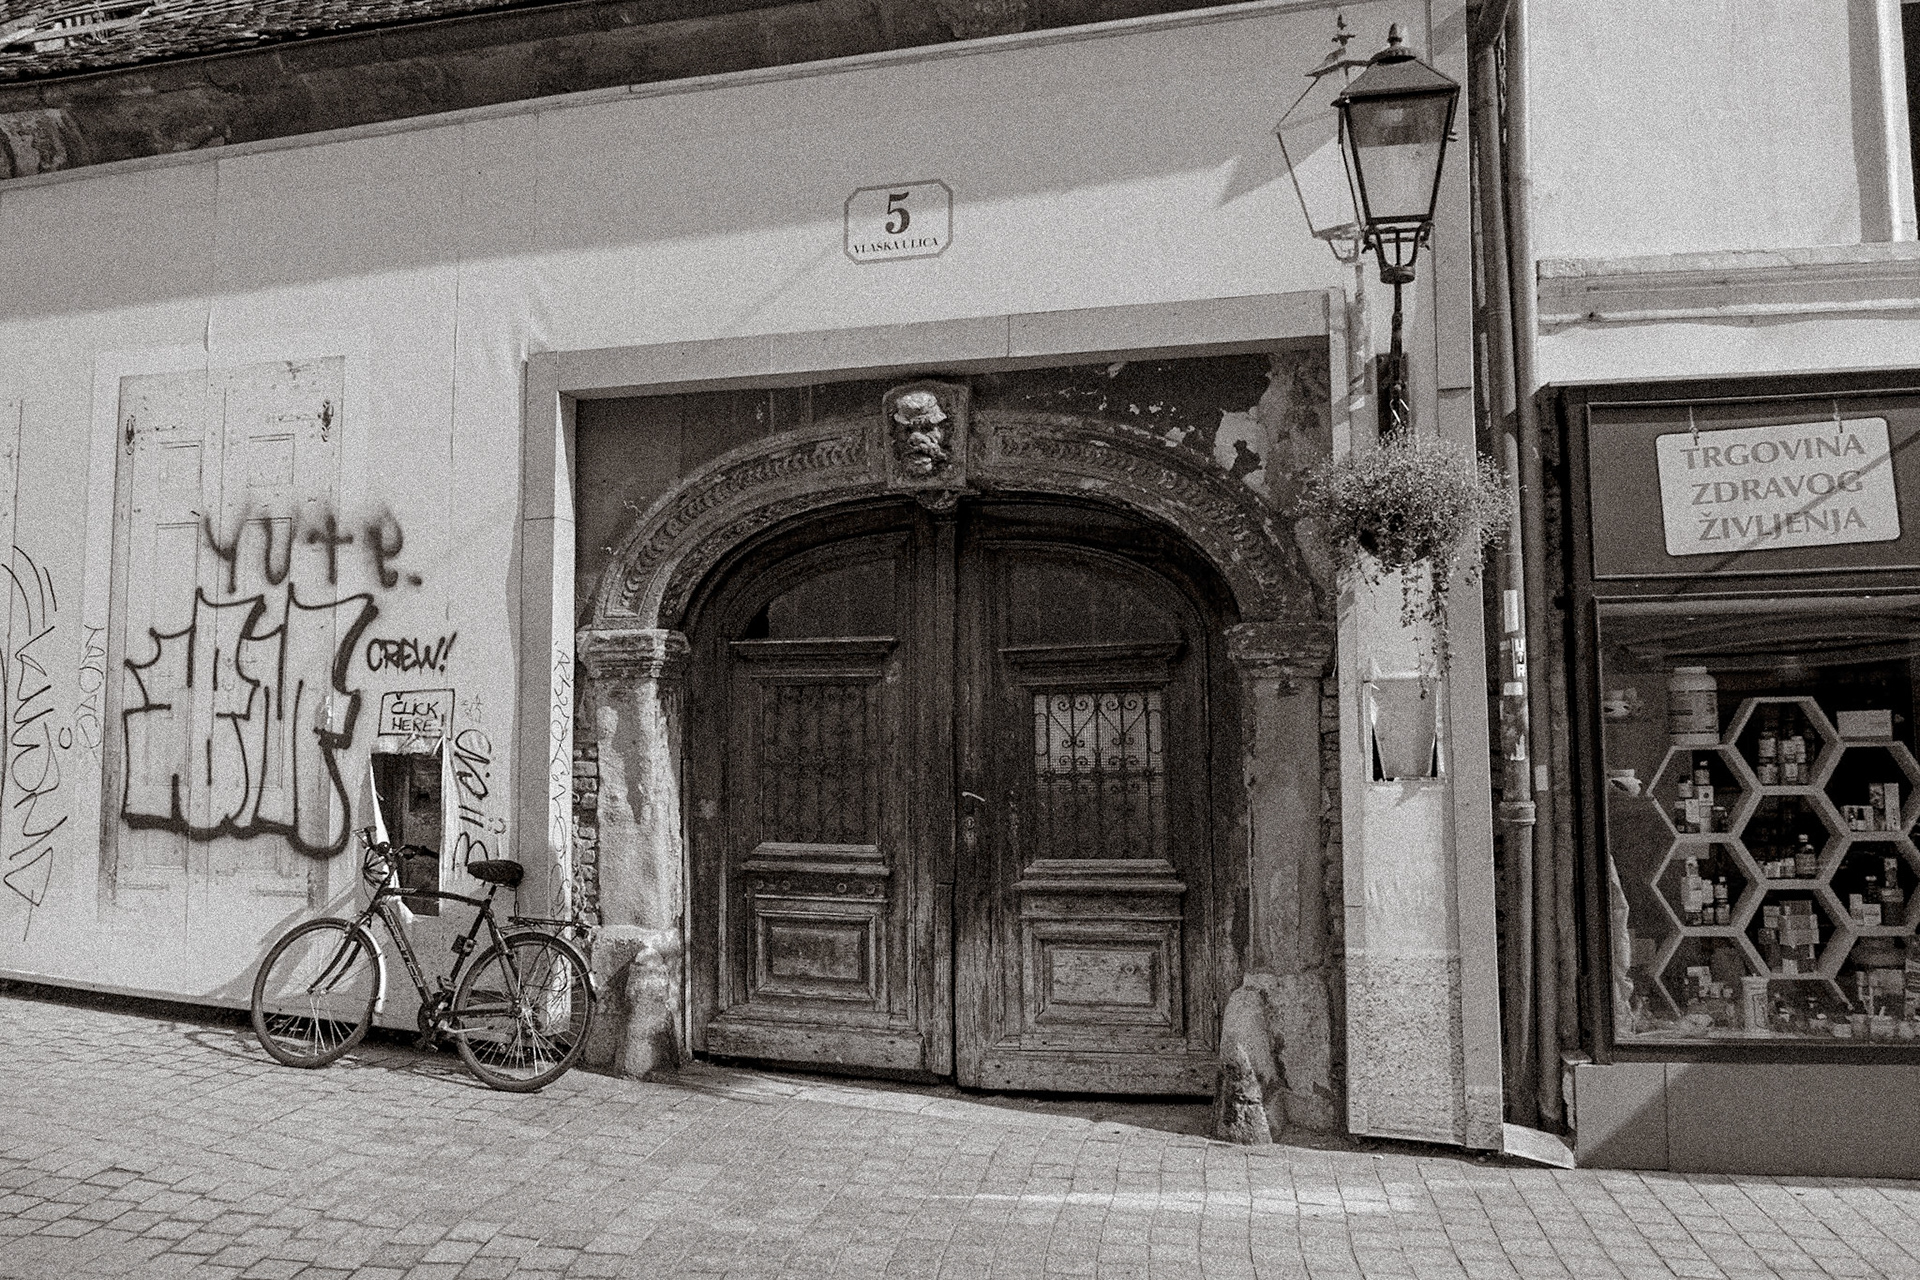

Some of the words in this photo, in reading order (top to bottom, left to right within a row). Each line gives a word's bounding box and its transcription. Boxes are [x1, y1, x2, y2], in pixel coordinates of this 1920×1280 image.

[885, 191, 910, 234] 5
[902, 237, 938, 249] ULICA
[1679, 433, 1867, 470] TRGOVINA
[1691, 470, 1864, 506] ZDRAVOG
[1698, 506, 1867, 541] ŽIVLJENJA
[366, 631, 458, 673] CREW!
[391, 713, 446, 732] HERE!
